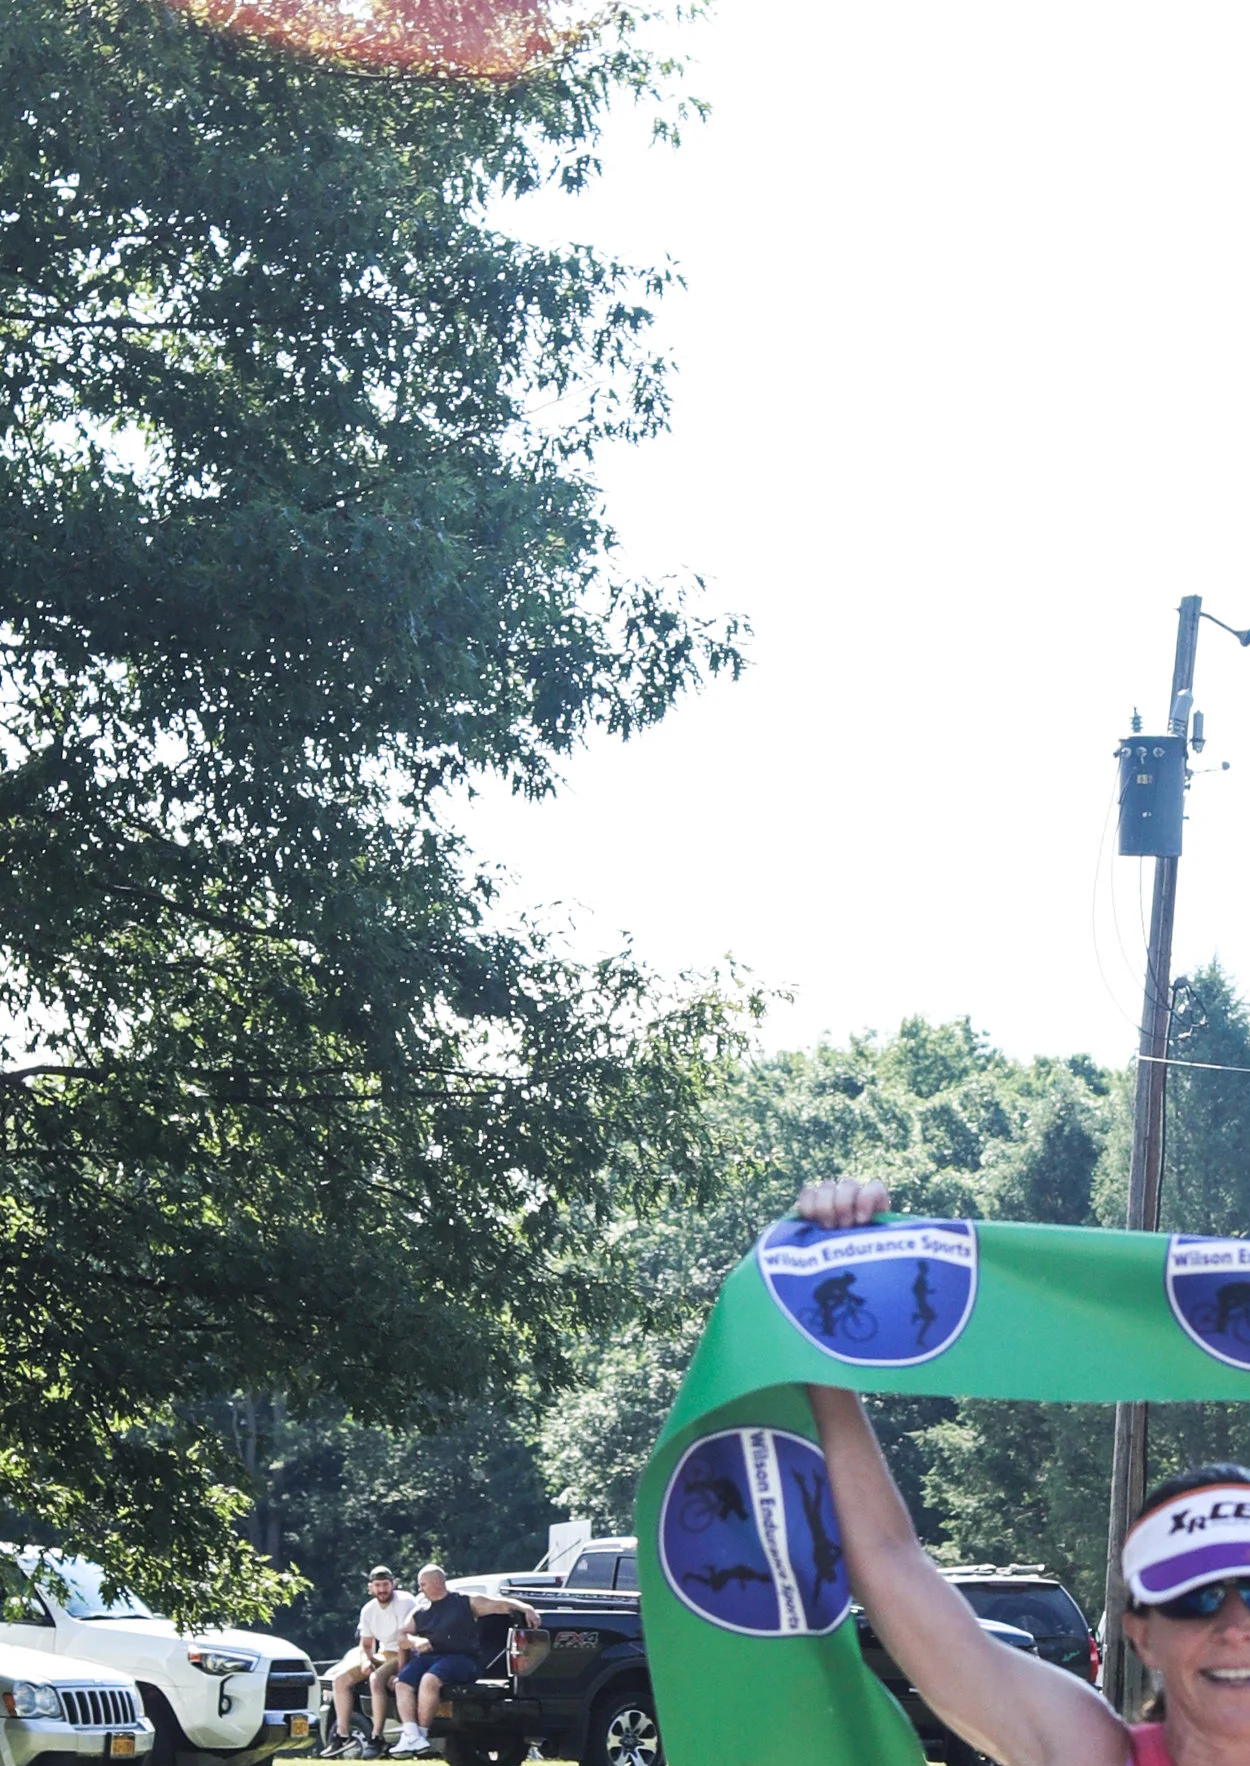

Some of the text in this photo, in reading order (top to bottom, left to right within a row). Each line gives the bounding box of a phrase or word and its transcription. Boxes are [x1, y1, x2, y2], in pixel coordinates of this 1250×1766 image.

[763, 1235, 972, 1269] Wilson Endurance Sports
[1172, 1250, 1233, 1267] Wilson
[750, 1430, 770, 1492] Wilson
[759, 1497, 789, 1579] Endurance
